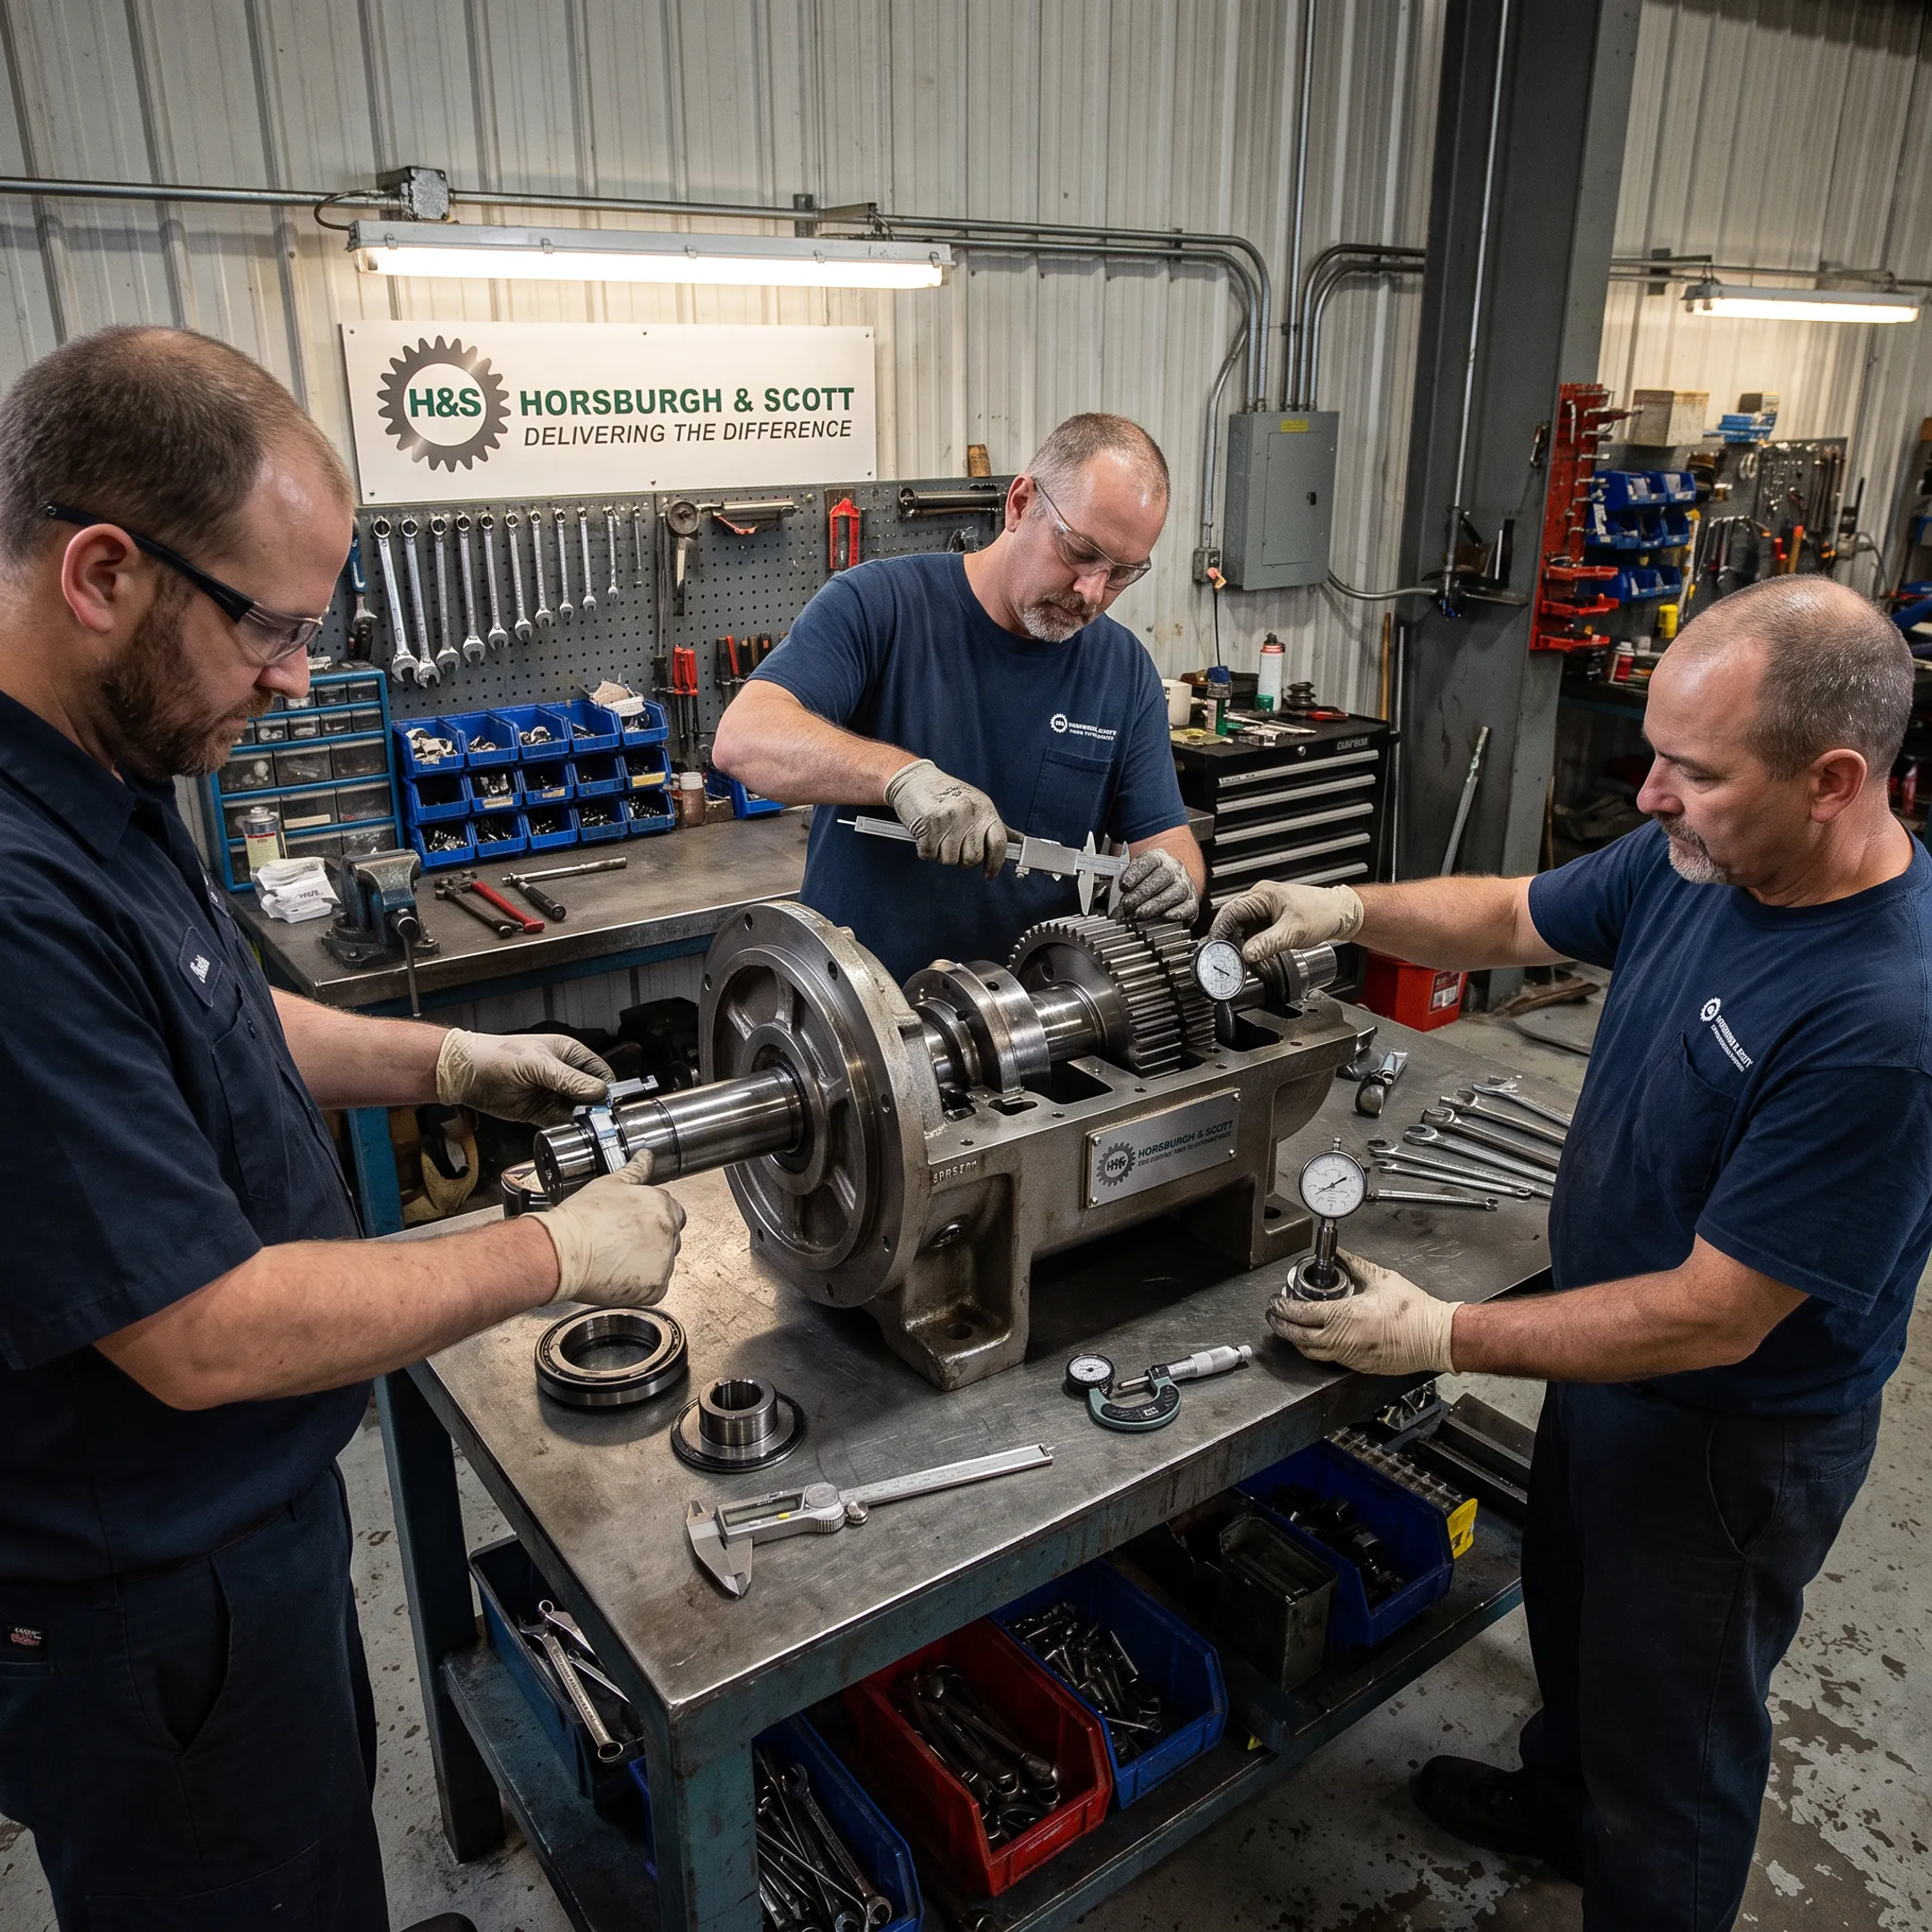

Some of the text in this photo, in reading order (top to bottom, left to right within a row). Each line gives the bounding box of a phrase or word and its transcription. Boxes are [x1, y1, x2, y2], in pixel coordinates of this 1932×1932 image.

[408, 386, 482, 418] H&S
[519, 386, 855, 416] HORSBURGH & SCOTT
[524, 419, 852, 446] DELIVERING THE DIFFERENCE
[1138, 1132, 1195, 1159] HORSBURGH
[1197, 1130, 1204, 1140] &
[1205, 1120, 1233, 1137] SCOTT
